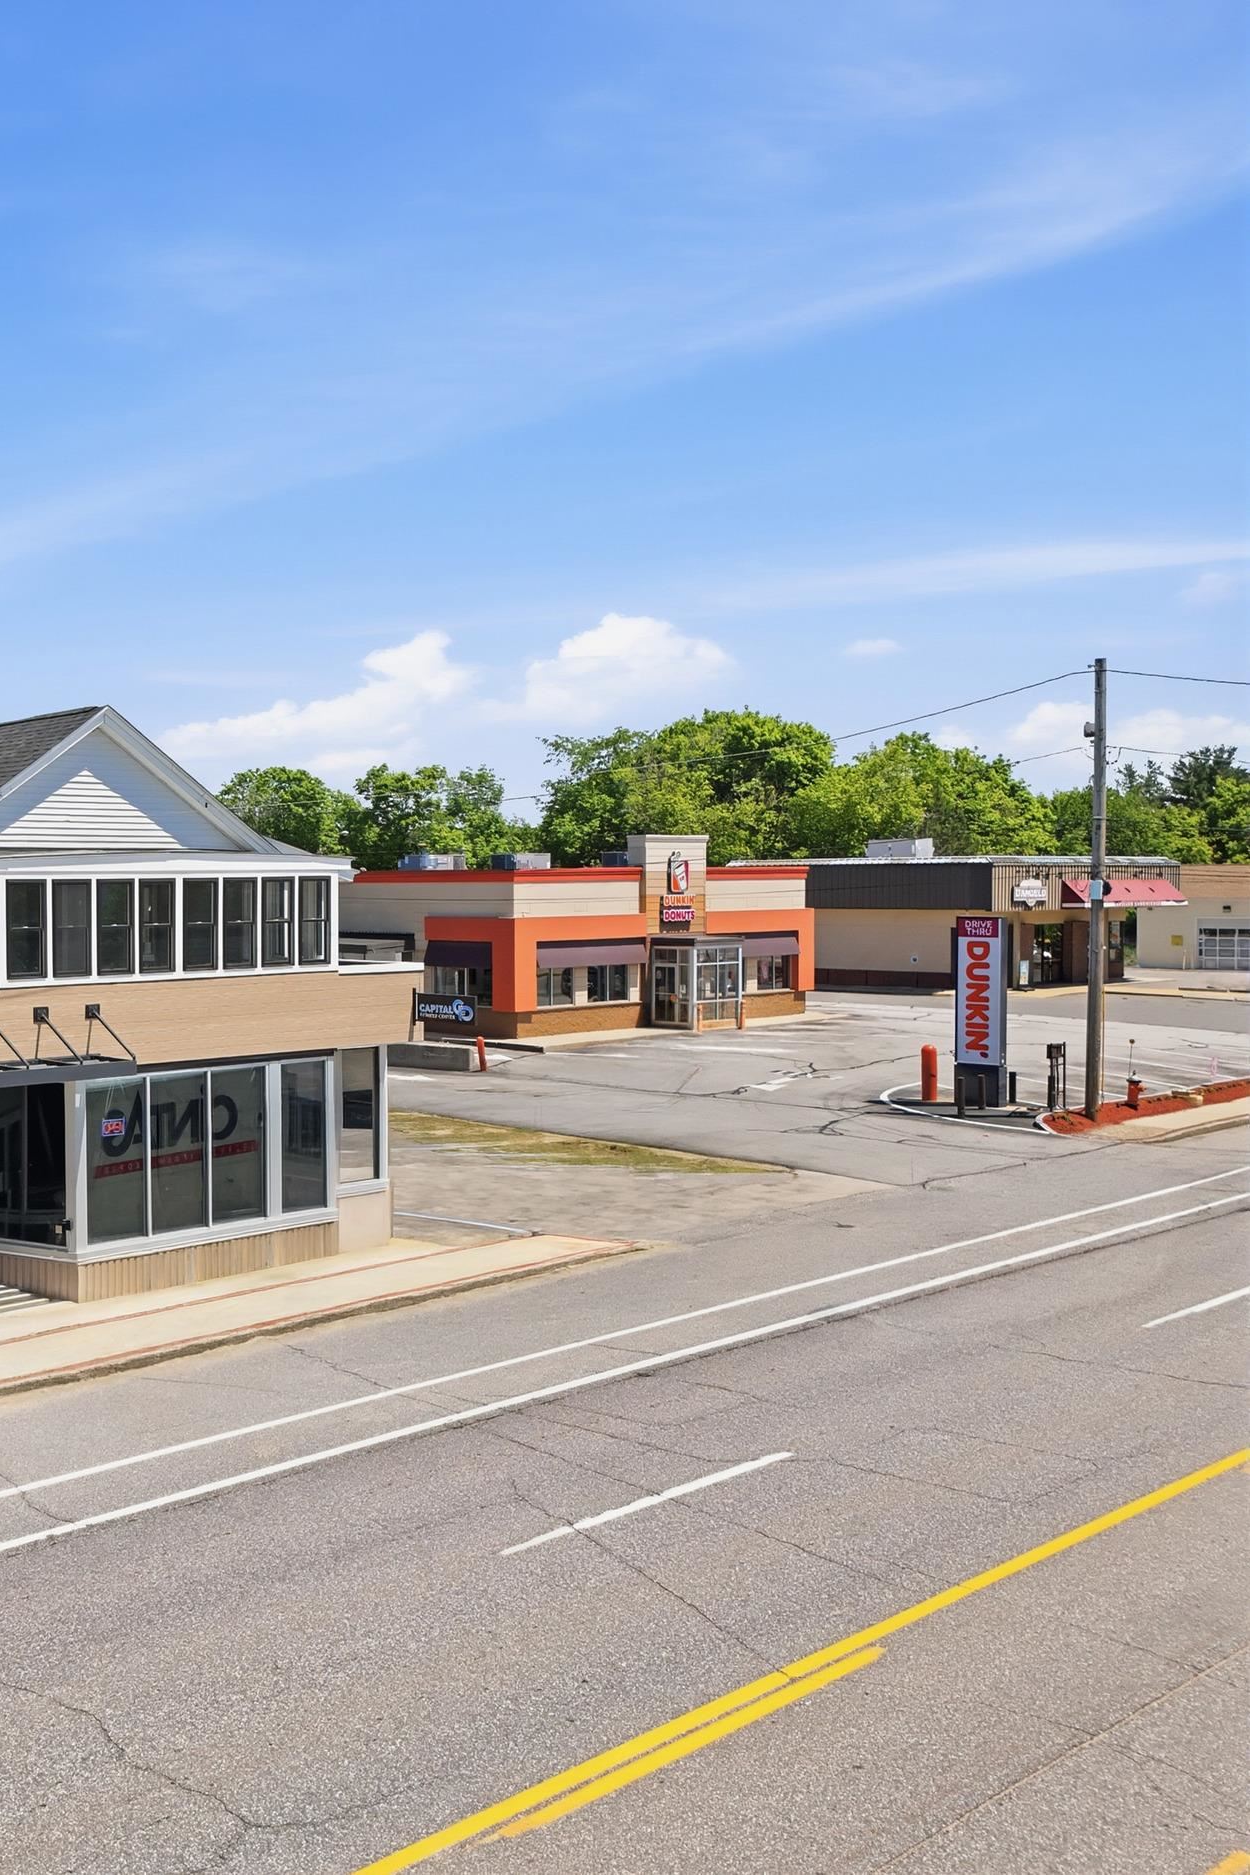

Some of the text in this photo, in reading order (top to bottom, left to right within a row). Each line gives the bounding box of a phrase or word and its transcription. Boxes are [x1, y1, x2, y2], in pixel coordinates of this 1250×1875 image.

[664, 895, 695, 906] DUNKIN'
[663, 909, 695, 921] DONUTS
[965, 920, 993, 928] DRIVE
[966, 927, 993, 936] THRU
[965, 941, 991, 1058] DUNKIN'
[419, 1003, 454, 1014] CAPITAL
